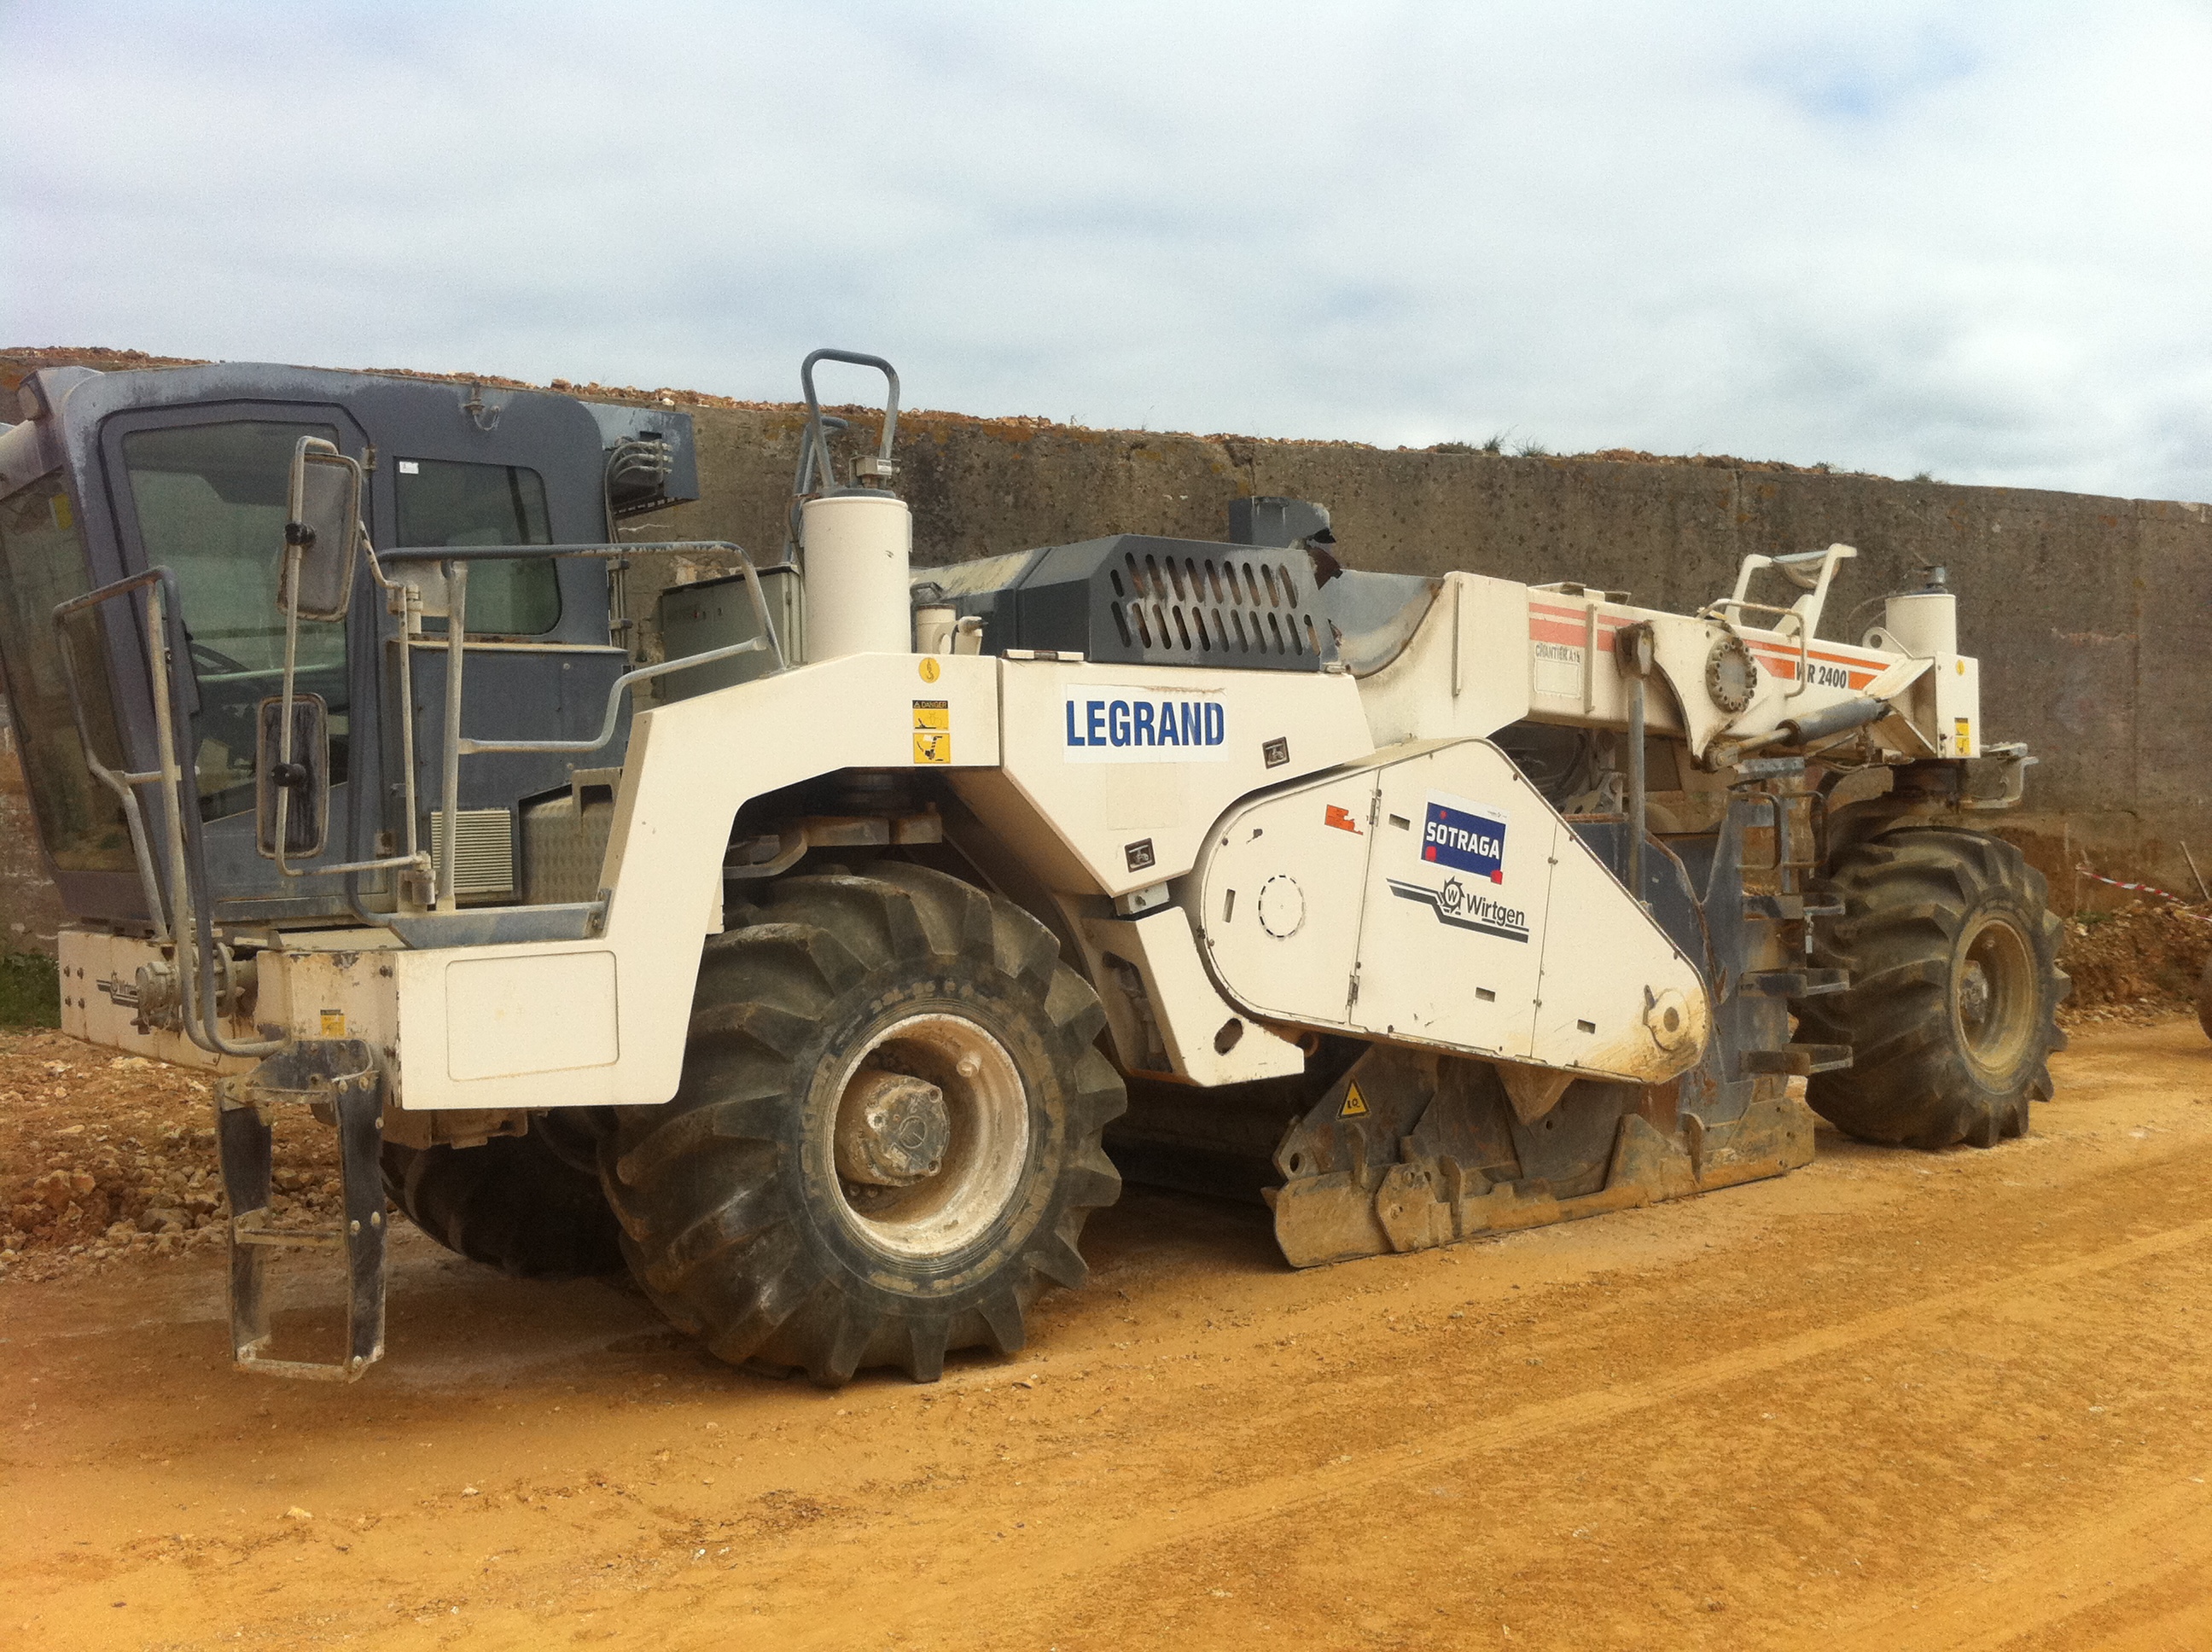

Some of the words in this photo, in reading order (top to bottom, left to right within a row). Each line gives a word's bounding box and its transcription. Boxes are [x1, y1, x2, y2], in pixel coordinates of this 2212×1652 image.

[1818, 666, 1847, 689] 2400
[1066, 700, 1225, 747] LEGRAND
[1426, 821, 1499, 860] SOTRAGA
[1466, 893, 1525, 926] Wirtgen
